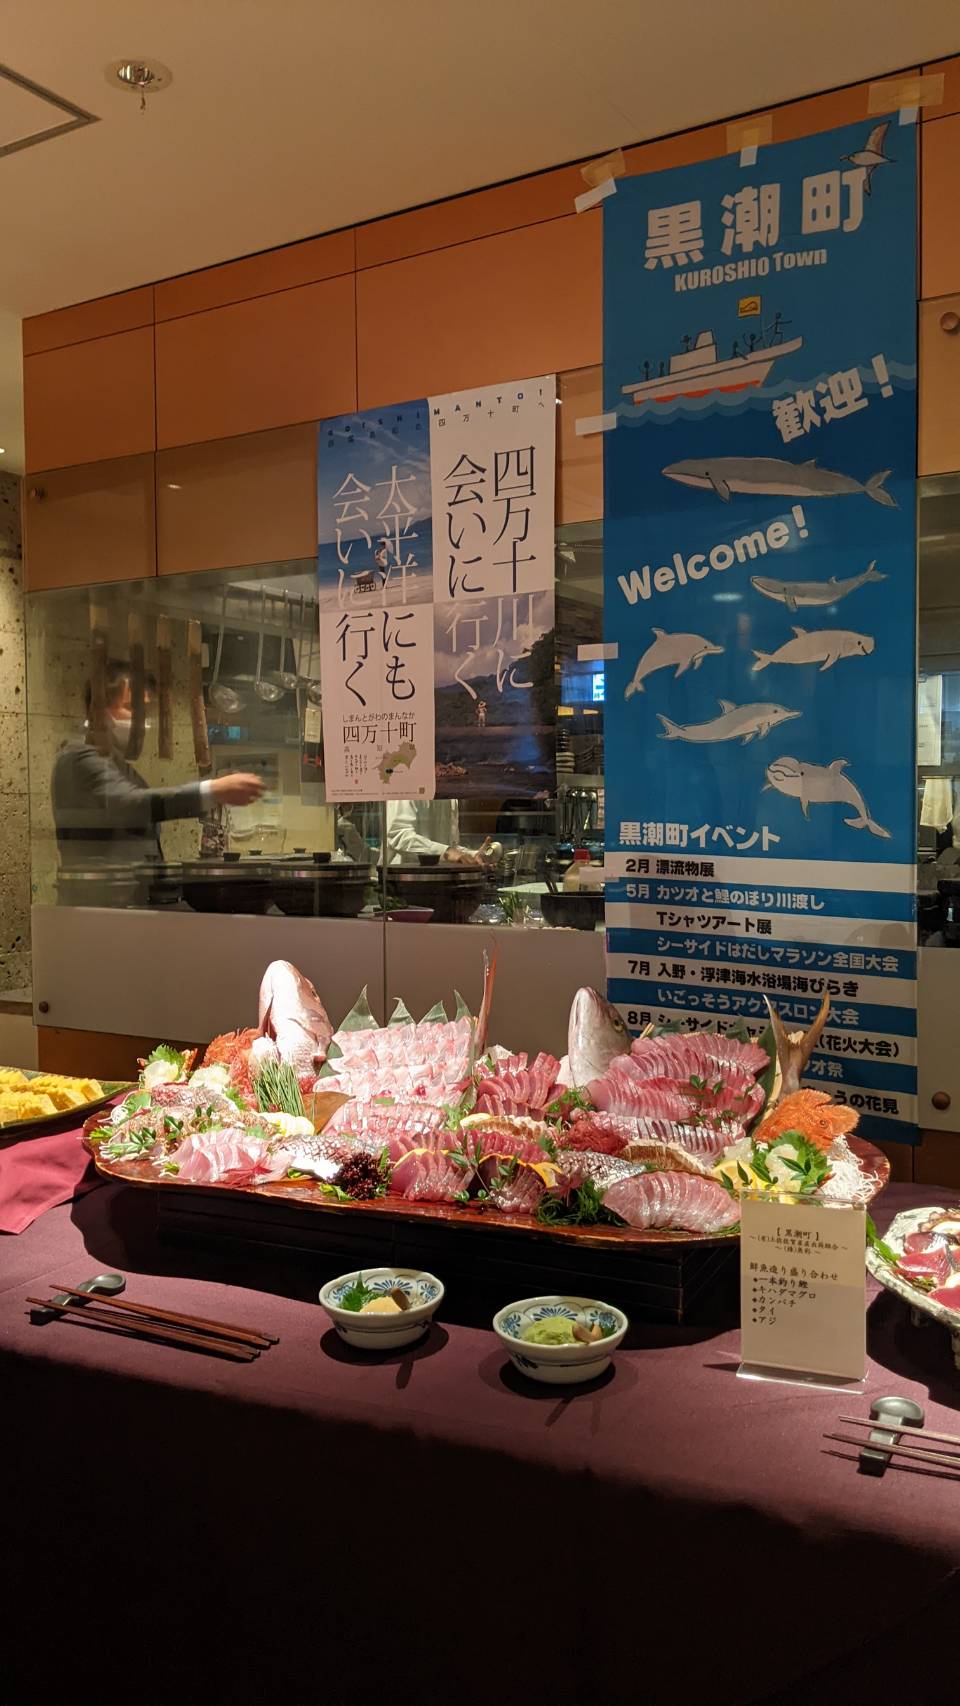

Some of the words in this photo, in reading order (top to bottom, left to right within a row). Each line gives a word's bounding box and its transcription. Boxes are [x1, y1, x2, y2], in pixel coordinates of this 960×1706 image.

[643, 167, 867, 270] 黒潮町
[674, 258, 770, 293] KUROSHIO
[773, 248, 828, 273] Town
[492, 444, 537, 693] 四万十川に
[617, 504, 810, 606] Welcome!
[332, 472, 376, 707] 会いに行く
[374, 464, 419, 701] 太平洋にも
[443, 453, 489, 700] 会いに行く
[342, 711, 416, 723] しまんとがわのまんなか
[342, 721, 417, 744] 四万十町
[618, 821, 782, 852] 黒潮町イベント
[625, 858, 650, 873] 2月
[656, 859, 715, 877] 漂流物展
[625, 884, 650, 899] 5月
[656, 911, 772, 935] Tシャツアート展
[627, 960, 650, 976] 7月
[656, 936, 899, 973] シーサイドはだしマラソン全国大会
[627, 1011, 650, 1026] 8月
